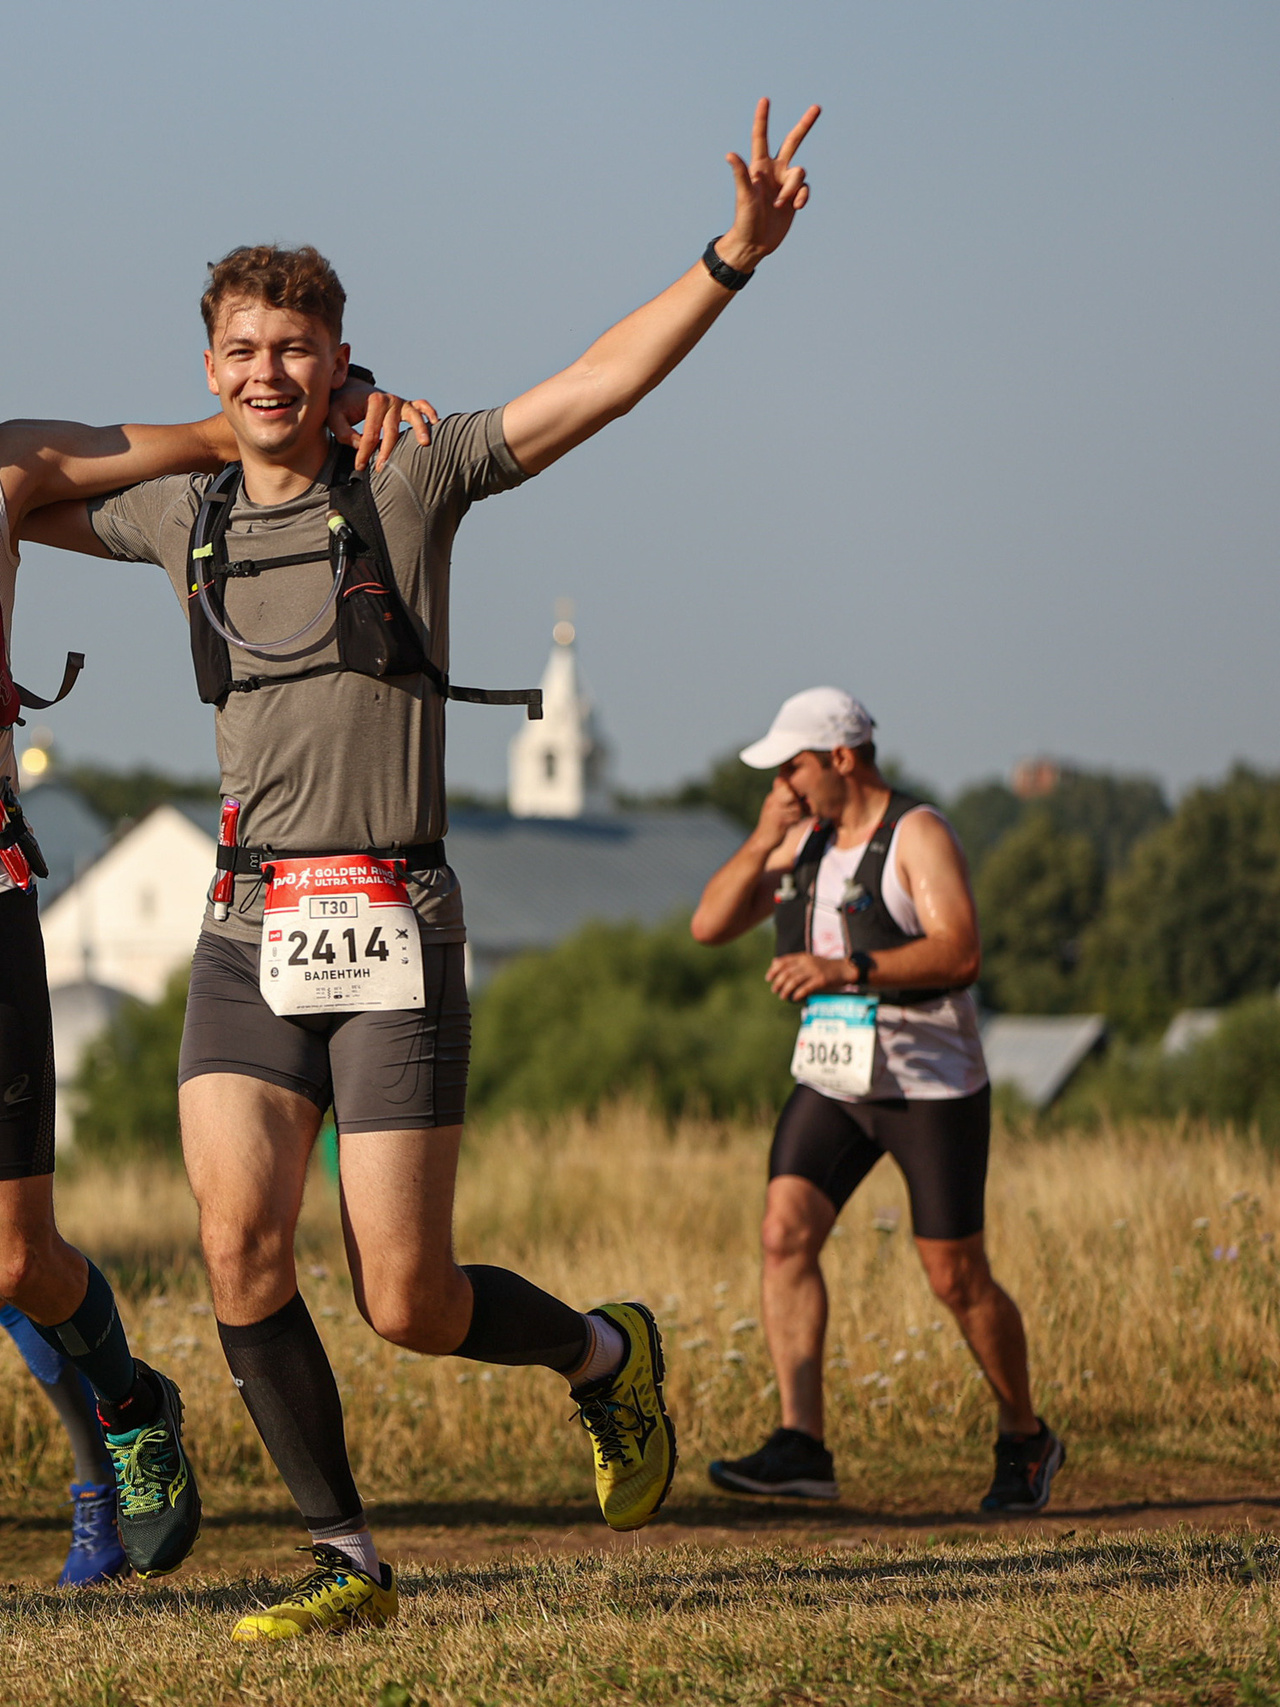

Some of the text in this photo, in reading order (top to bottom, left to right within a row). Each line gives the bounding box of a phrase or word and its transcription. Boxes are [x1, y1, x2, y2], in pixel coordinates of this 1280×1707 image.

[314, 866, 394, 879] GOLDEN RING
[314, 878, 349, 887] ULTRA
[350, 876, 383, 885] TRAIL
[319, 900, 348, 915] T30
[288, 926, 389, 966] 2414
[304, 968, 371, 981] ВАЛЕНТИН
[806, 1042, 852, 1065] 3063
